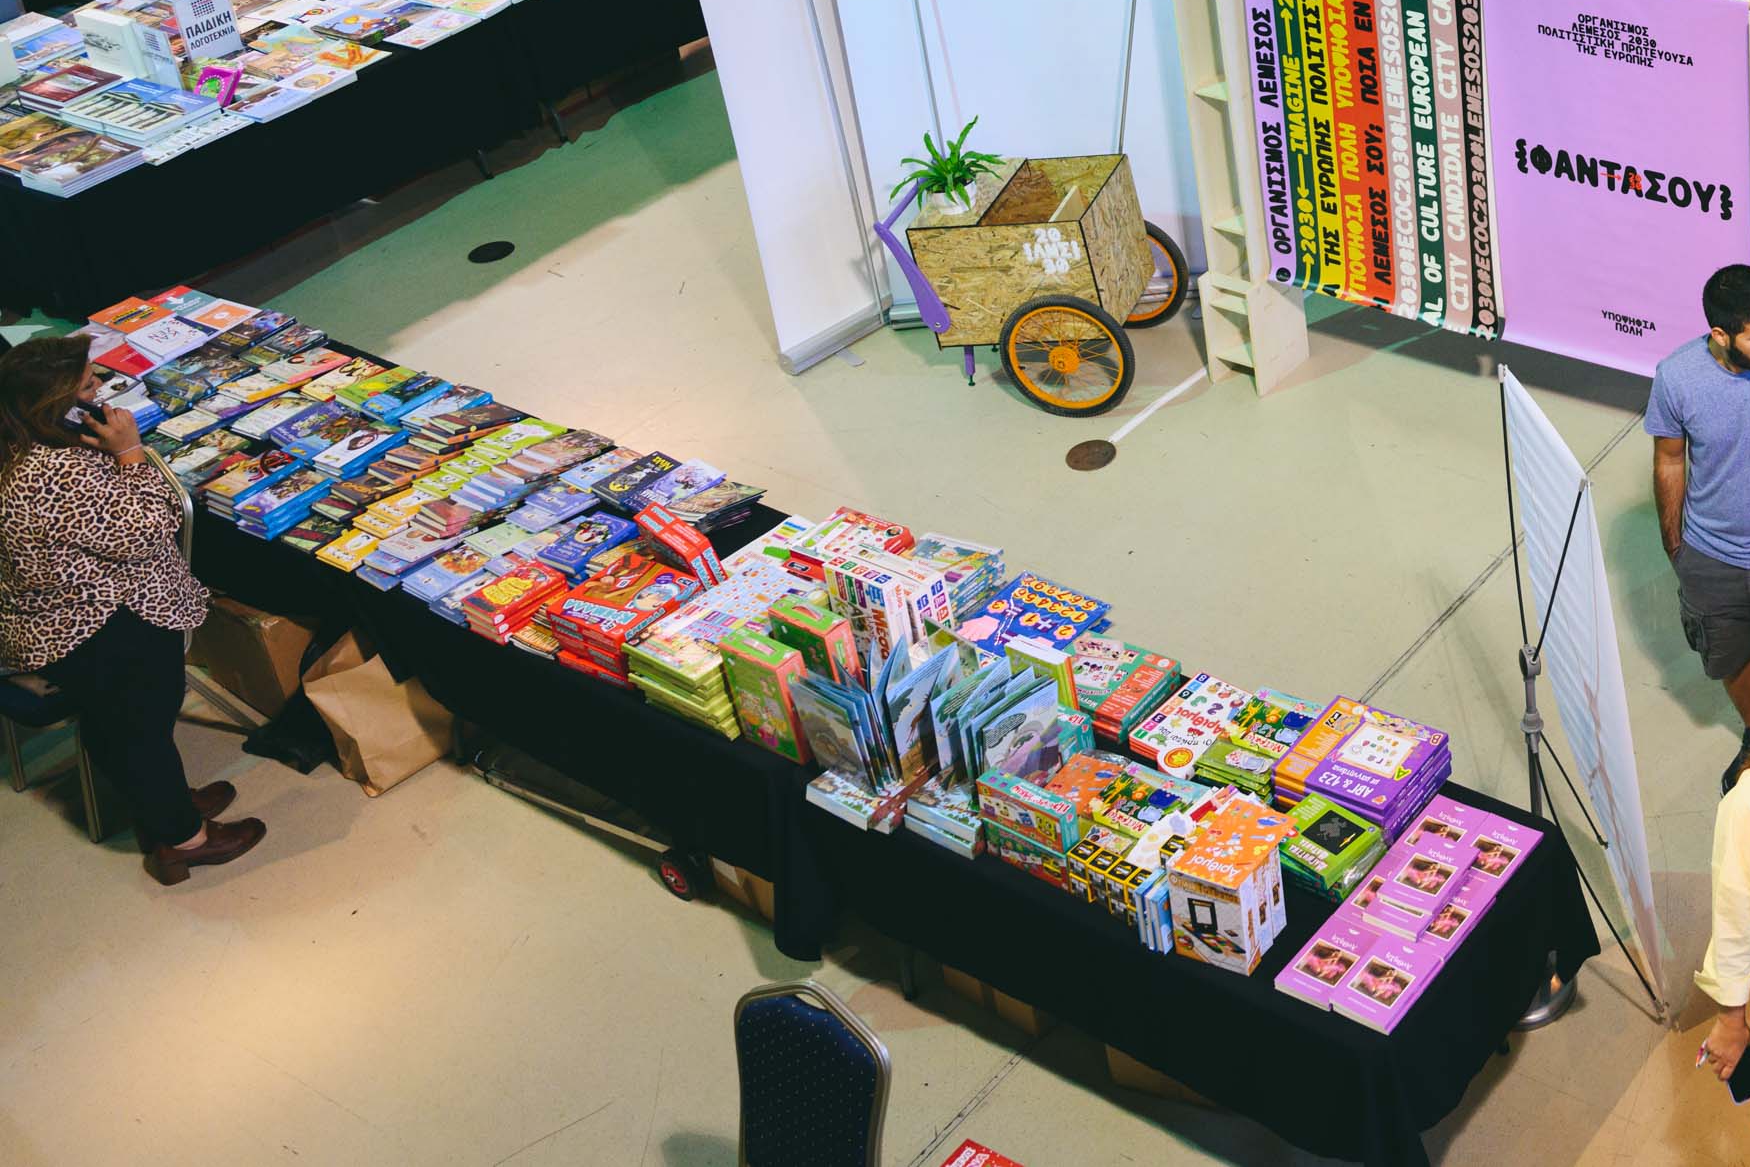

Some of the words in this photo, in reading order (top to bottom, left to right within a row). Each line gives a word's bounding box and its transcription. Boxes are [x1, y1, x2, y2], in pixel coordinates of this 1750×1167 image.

[185, 10, 233, 39] ΠΑΙΔΙΚΗ
[190, 24, 236, 52] ΛΟΓΟΤΕΧΝΙΑ
[1353, 1, 1373, 33] ΕΝ
[1538, 25, 1614, 49] ΠΟΛΙΤΙΣΤΙΚΗ
[1622, 43, 1693, 66] ΠΡΩΤΕΥΟΥΣΑ
[1572, 22, 1621, 40] ΛΕΜΕΣΟΣ
[1629, 35, 1657, 48] 2030
[1578, 14, 1648, 37] ΟΡΓΑΝΙΣΜΟΣ
[1252, 7, 1279, 108] ΛΕΜΕΣΟΣ
[1358, 47, 1379, 105] ΠΟΙΑ
[1407, 9, 1433, 131] EUROPEAN
[1435, 38, 1457, 100] CITY
[1576, 43, 1597, 56] ΤΗΣ
[1605, 50, 1654, 68] ΕΥΡΩΠΗΣ
[1282, 54, 1308, 156] IMAGINE
[1313, 117, 1338, 215] ΕΥΡΩΠΗΣ
[1338, 122, 1360, 182] ΠΟΛΗ
[1440, 112, 1466, 242] CANDIDATE
[1262, 121, 1292, 255] ΟΡΓΑΝΙΣΜΟΣ
[1416, 142, 1440, 242] CULTURE
[1296, 196, 1317, 255] 2030
[1322, 227, 1341, 267] ΤΗΣ
[1368, 186, 1392, 286] ΛΕΜΕΣΟΣ
[1423, 253, 1442, 283] OF
[1449, 253, 1469, 311] CITY
[1615, 322, 1642, 337] ΠΟΛΗ
